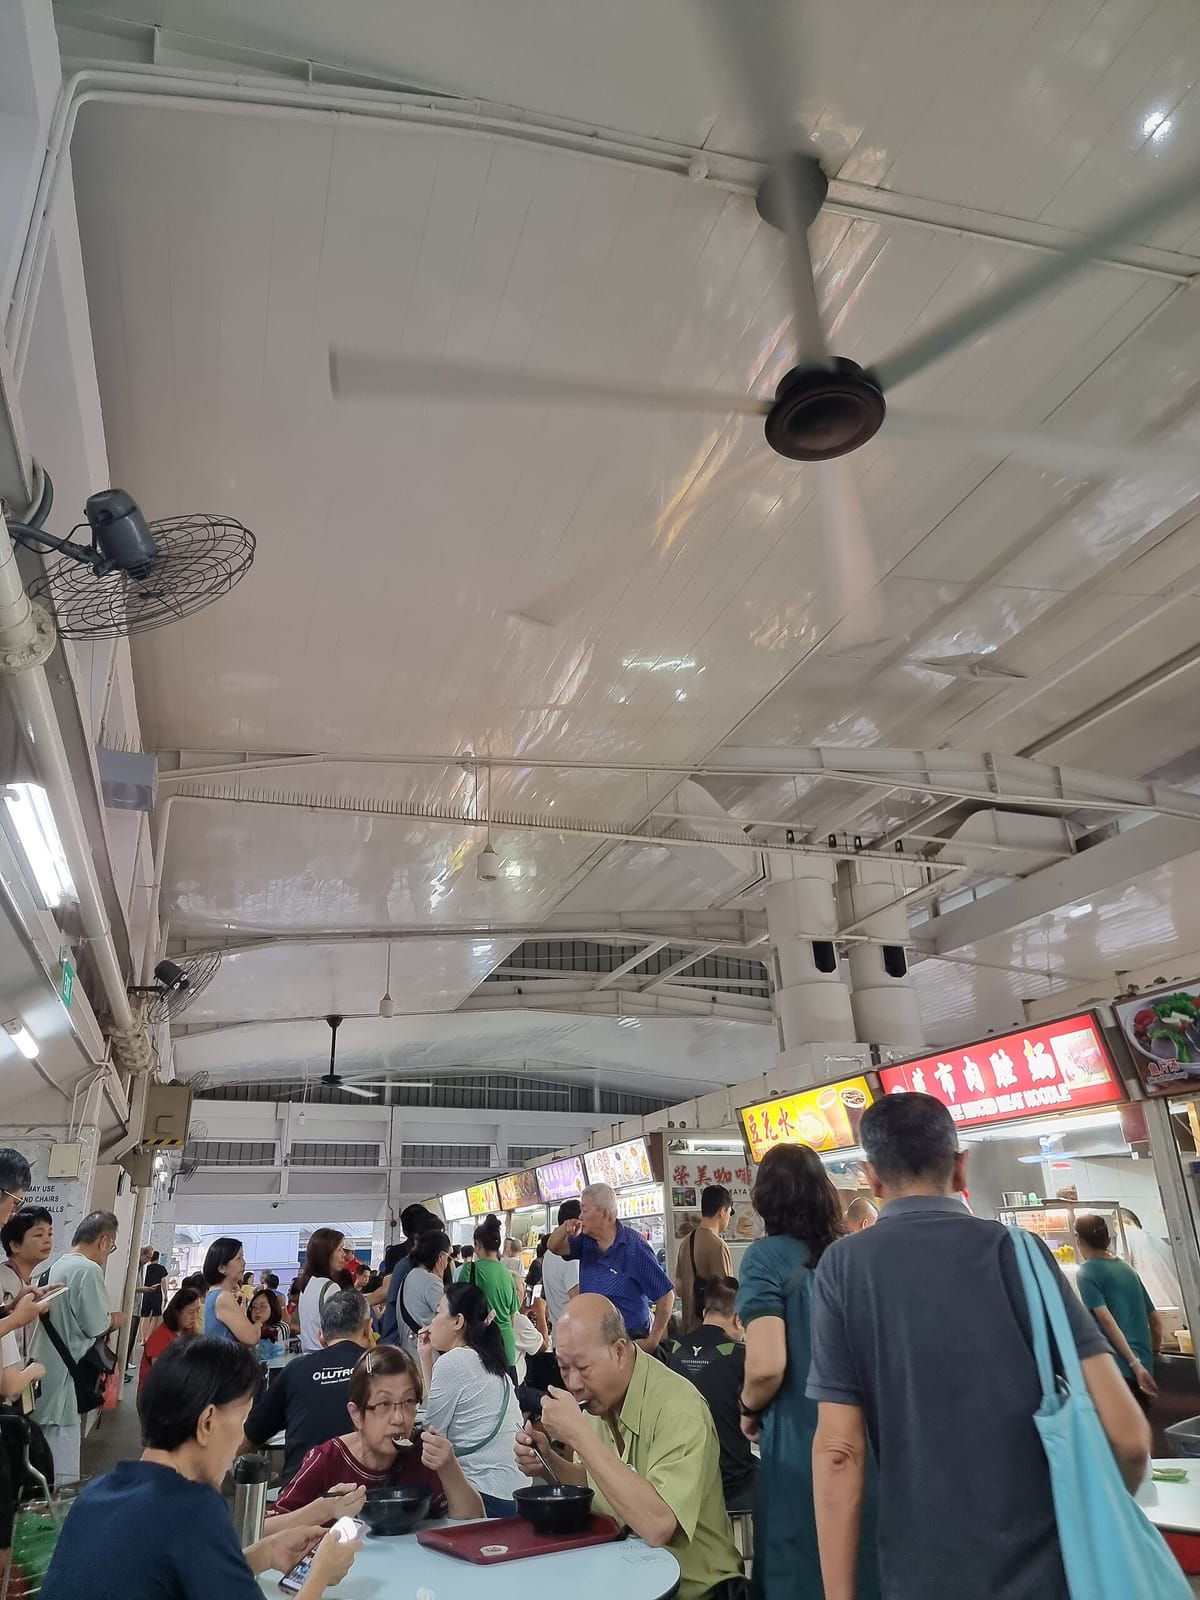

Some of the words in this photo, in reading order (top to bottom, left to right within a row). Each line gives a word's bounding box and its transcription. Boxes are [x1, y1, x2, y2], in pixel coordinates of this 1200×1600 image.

[1023, 1083, 1072, 1108] NOODLE
[747, 1106, 796, 1144] 豆花水
[34, 1195, 59, 1203] CHAIRS
[45, 1205, 65, 1213] TALLS
